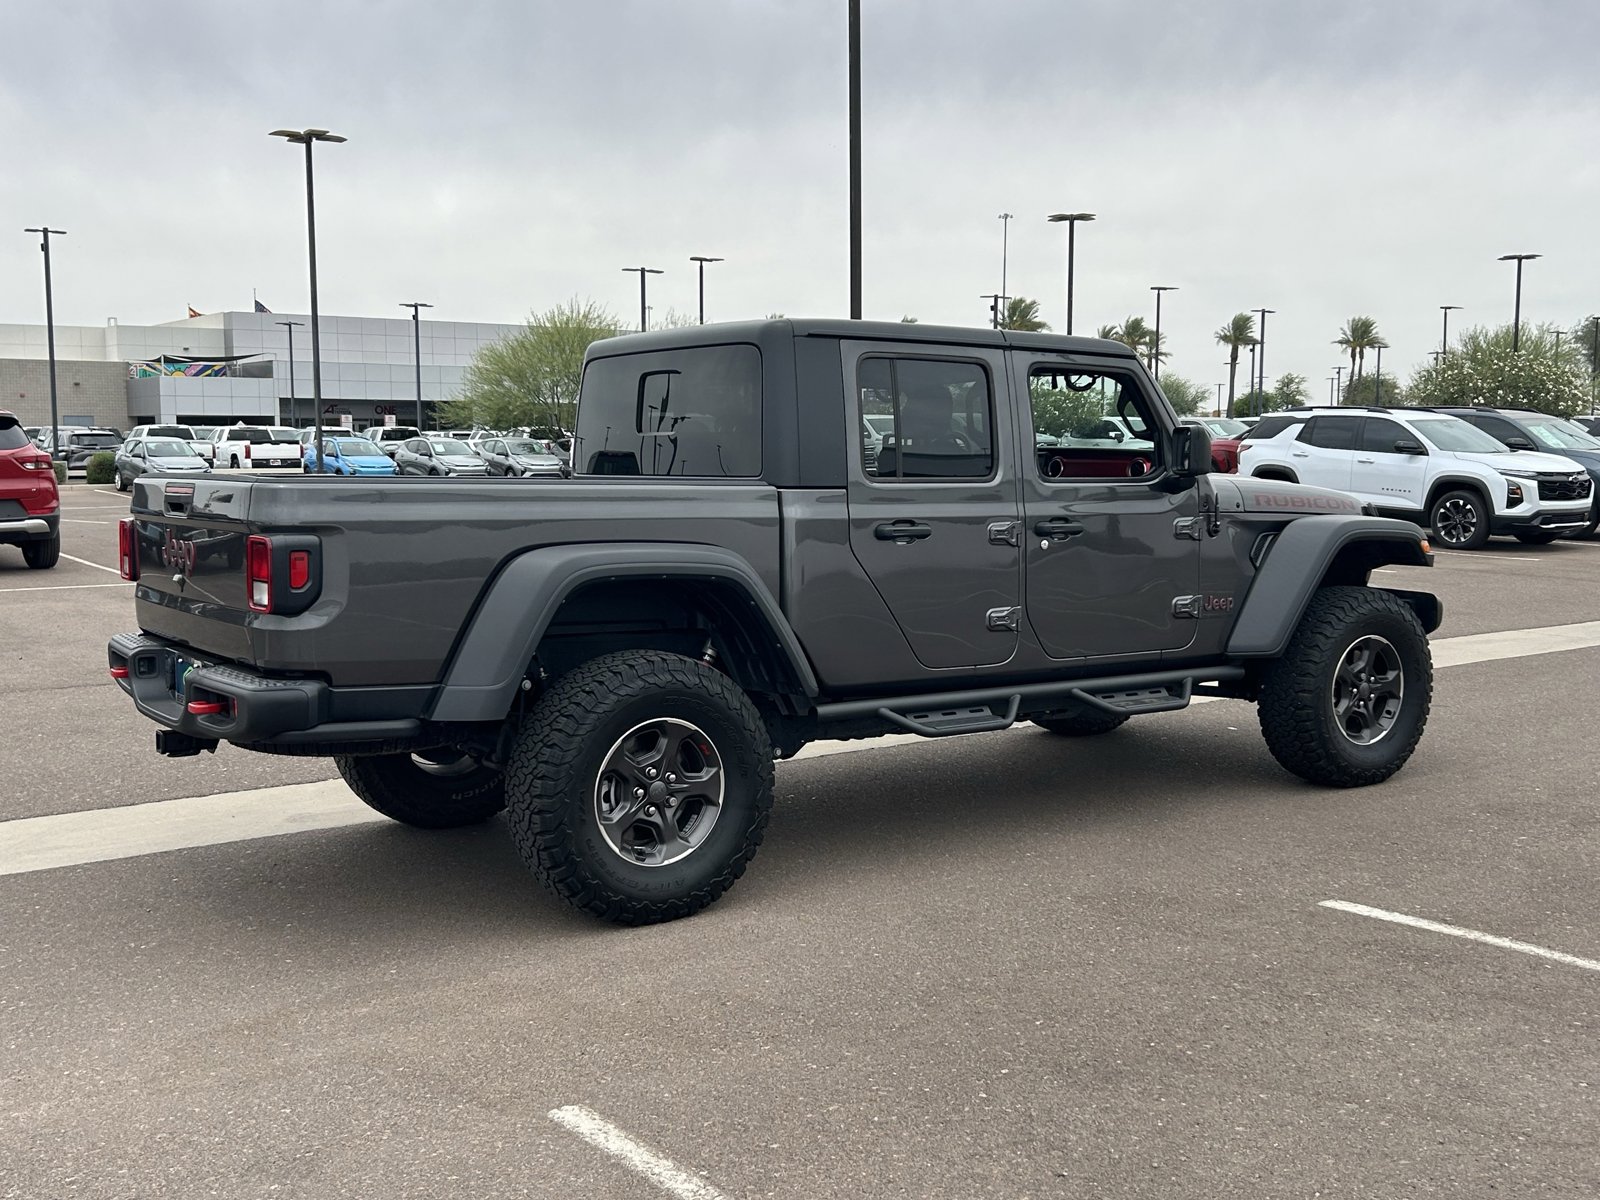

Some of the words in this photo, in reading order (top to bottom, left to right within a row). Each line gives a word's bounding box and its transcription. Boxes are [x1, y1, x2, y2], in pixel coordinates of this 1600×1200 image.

[375, 405, 397, 415] ONE
[1254, 494, 1356, 510] RUBICON
[162, 529, 196, 578] Jeep
[1204, 596, 1233, 611] Jeep
